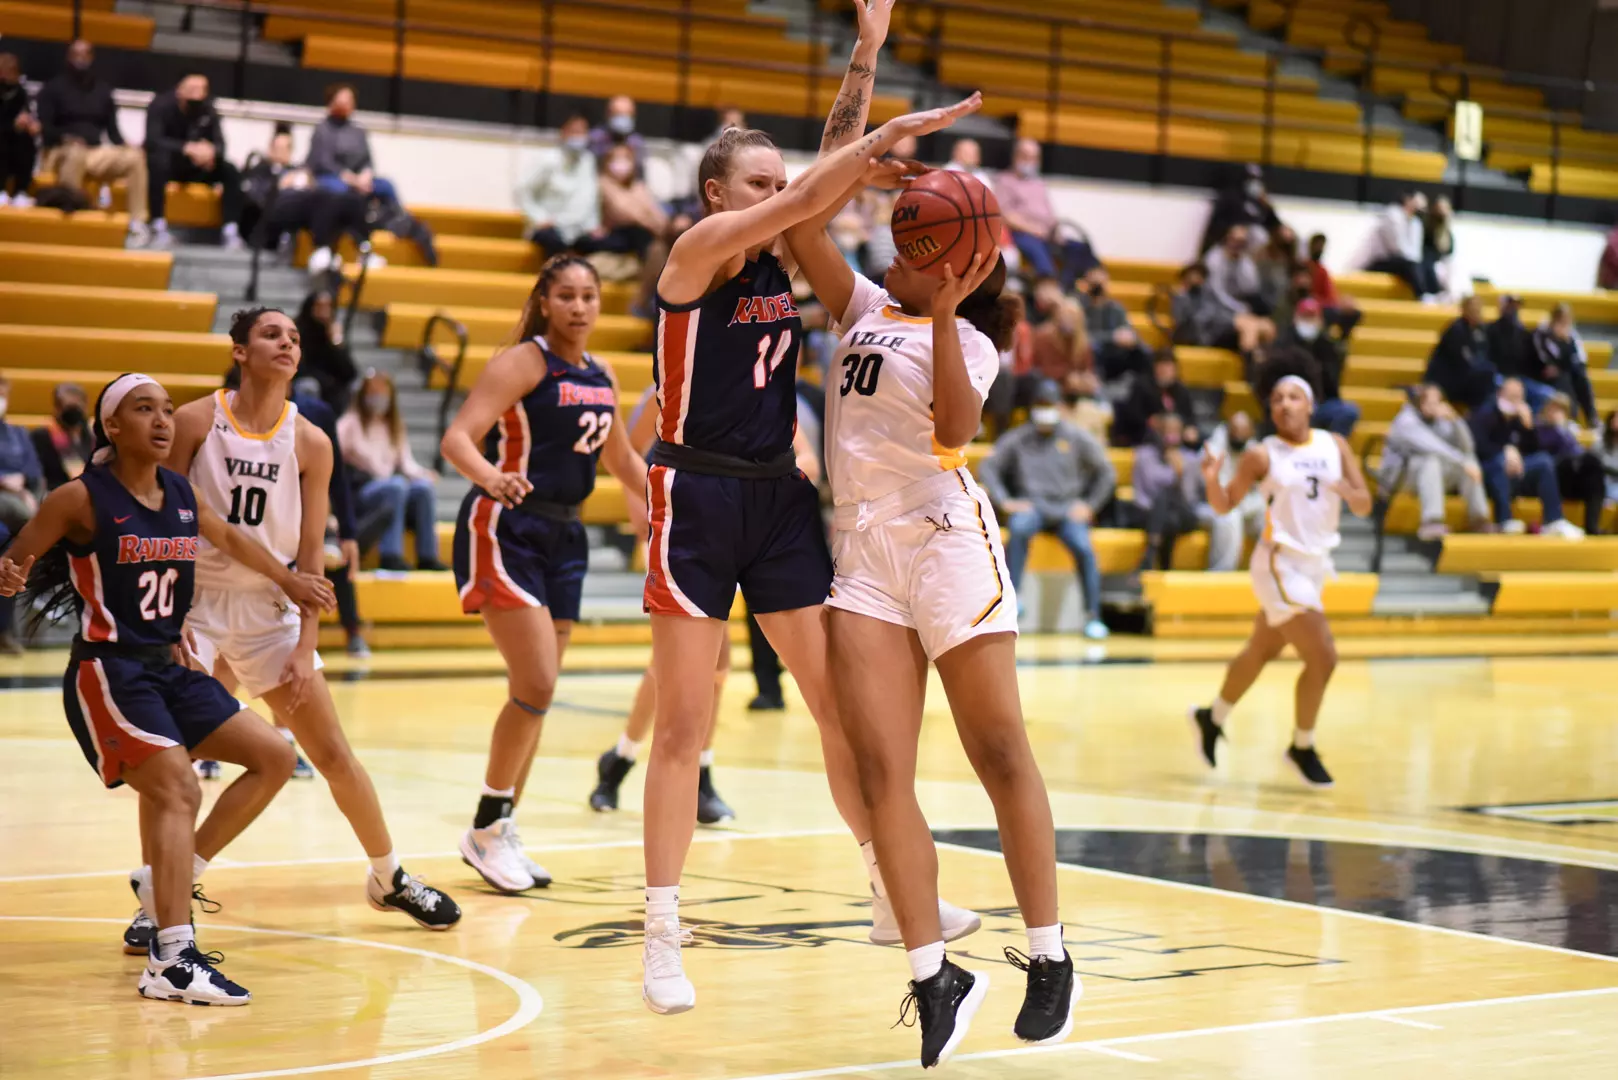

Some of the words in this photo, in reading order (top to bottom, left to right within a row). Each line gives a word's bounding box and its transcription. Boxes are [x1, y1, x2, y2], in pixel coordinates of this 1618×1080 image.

[840, 353, 884, 397] 30
[224, 456, 280, 484] VILLE
[1305, 475, 1319, 500] 3
[227, 485, 267, 526] 10
[116, 534, 199, 564] RAIDERS
[138, 568, 179, 620] 20
